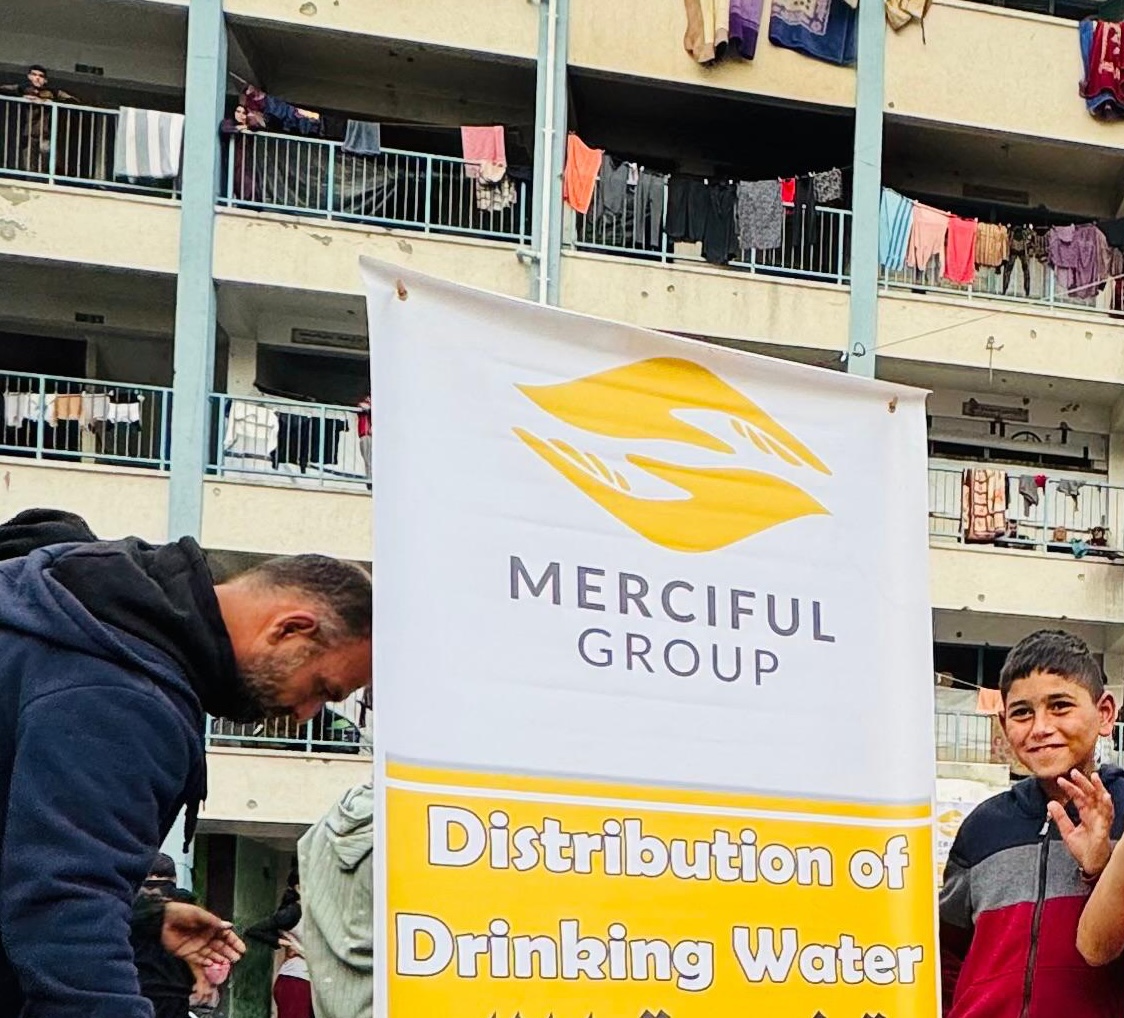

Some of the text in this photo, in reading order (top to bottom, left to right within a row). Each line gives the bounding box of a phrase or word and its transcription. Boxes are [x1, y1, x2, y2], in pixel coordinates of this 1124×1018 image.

[510, 556, 836, 644] MERCIFUL
[578, 628, 780, 687] GROUP
[427, 804, 910, 890] Distribution of
[395, 911, 924, 992] Drinking Water
